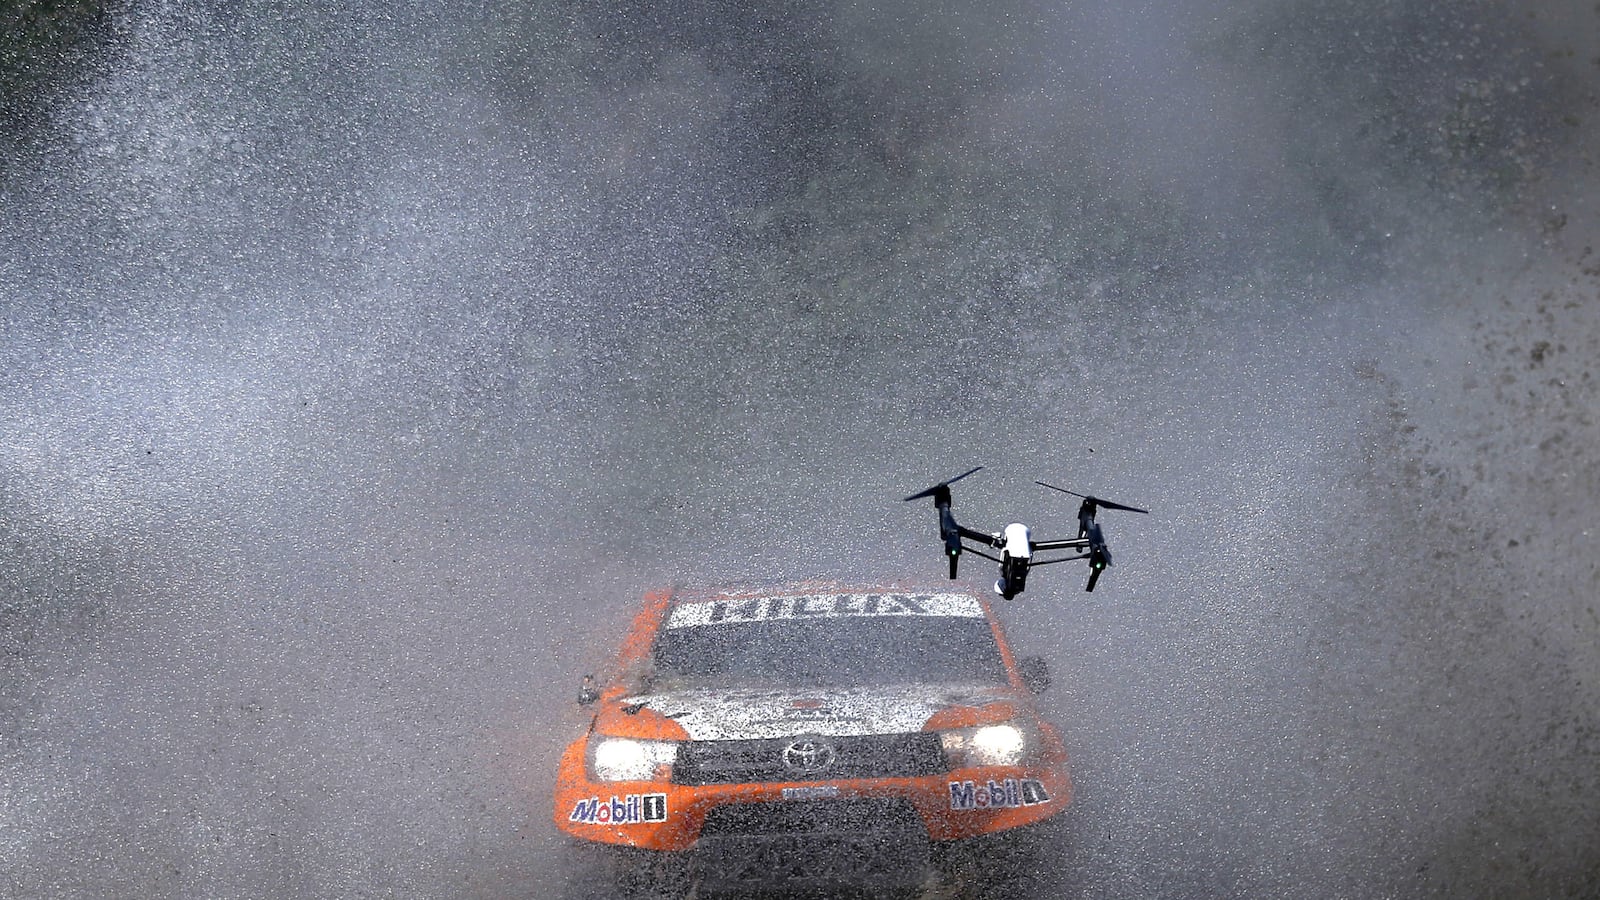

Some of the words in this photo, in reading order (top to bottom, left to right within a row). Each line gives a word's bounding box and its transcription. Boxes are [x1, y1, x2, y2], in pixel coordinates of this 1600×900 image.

[709, 594, 929, 621] HILUX
[948, 780, 1019, 808] Mobil
[570, 796, 639, 823] Mobil
